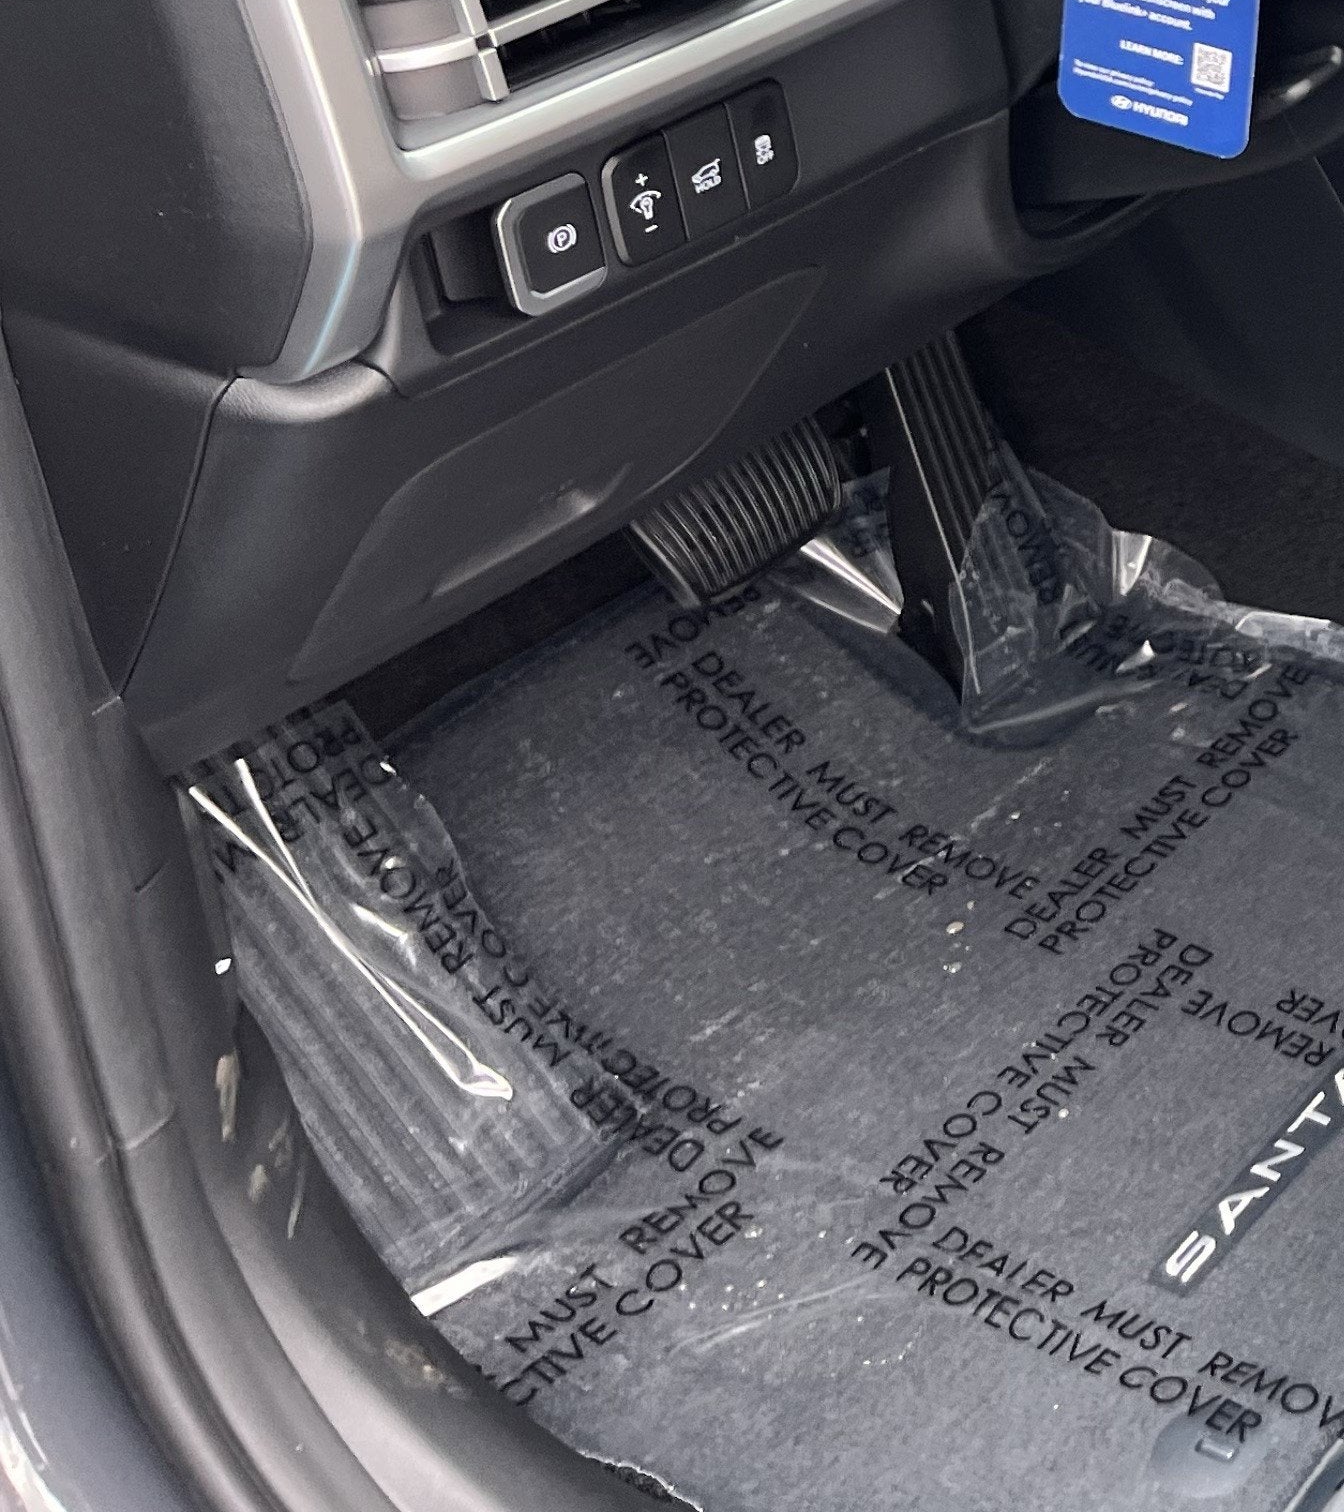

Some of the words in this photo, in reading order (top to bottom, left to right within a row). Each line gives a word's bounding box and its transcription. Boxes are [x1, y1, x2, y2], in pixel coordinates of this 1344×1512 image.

[1119, 39, 1152, 56] LEARN
[1132, 101, 1190, 127] HYUNDAI
[660, 671, 839, 833] PROTECTIVE
[831, 823, 951, 898] COVER
[691, 650, 806, 753] DEALER
[806, 759, 898, 826] MUST
[898, 823, 1041, 901] REMOVE
[1003, 844, 1123, 942] DEALER
[1119, 773, 1198, 840] MUST
[1195, 662, 1312, 773] REMOVE
[1038, 802, 1212, 956] PROTECTIVE
[1199, 726, 1301, 826] COVER
[342, 819, 475, 975] REMOVE
[435, 858, 531, 990] COVER
[470, 984, 582, 1070] MUST
[997, 925, 1179, 1092] PROTECTIVE
[1105, 942, 1214, 1049] DEALER
[1180, 985, 1337, 1071] REMOVE
[527, 991, 741, 1135] PROTECTIVE
[568, 1078, 706, 1174] DEALER
[1006, 1054, 1097, 1135] MUST
[851, 1138, 1005, 1272] REMOVE
[879, 1089, 1003, 1196] COVER
[504, 1261, 617, 1357] MUST
[618, 1124, 787, 1257] REMOVE
[614, 1198, 756, 1321] COVER
[931, 1223, 1075, 1304] DEALER
[1080, 1298, 1194, 1361] MUST
[895, 1254, 1122, 1379] PROTECTIVE
[1117, 1361, 1266, 1445] COVER
